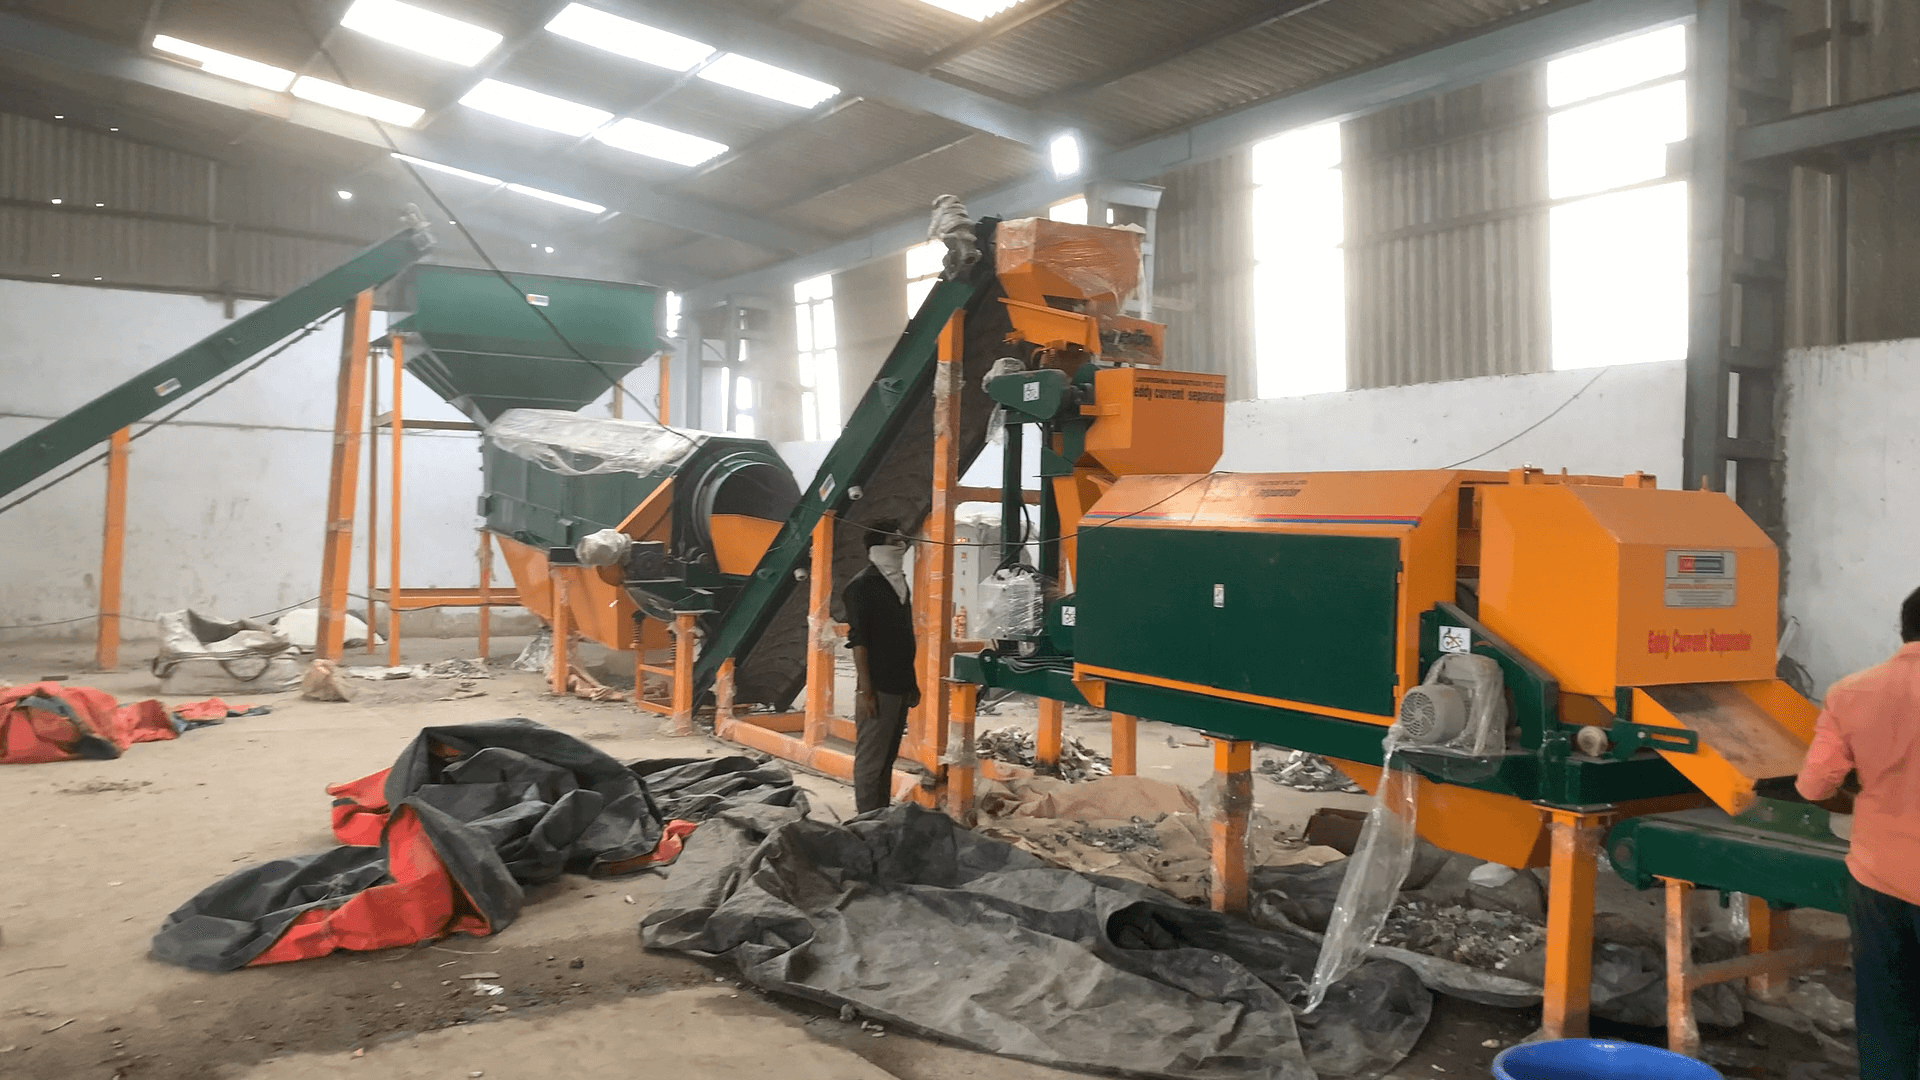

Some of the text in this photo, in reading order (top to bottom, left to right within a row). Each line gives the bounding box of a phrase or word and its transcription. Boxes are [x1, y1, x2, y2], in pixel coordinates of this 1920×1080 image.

[1648, 628, 1753, 659] Eddy Current Separator
